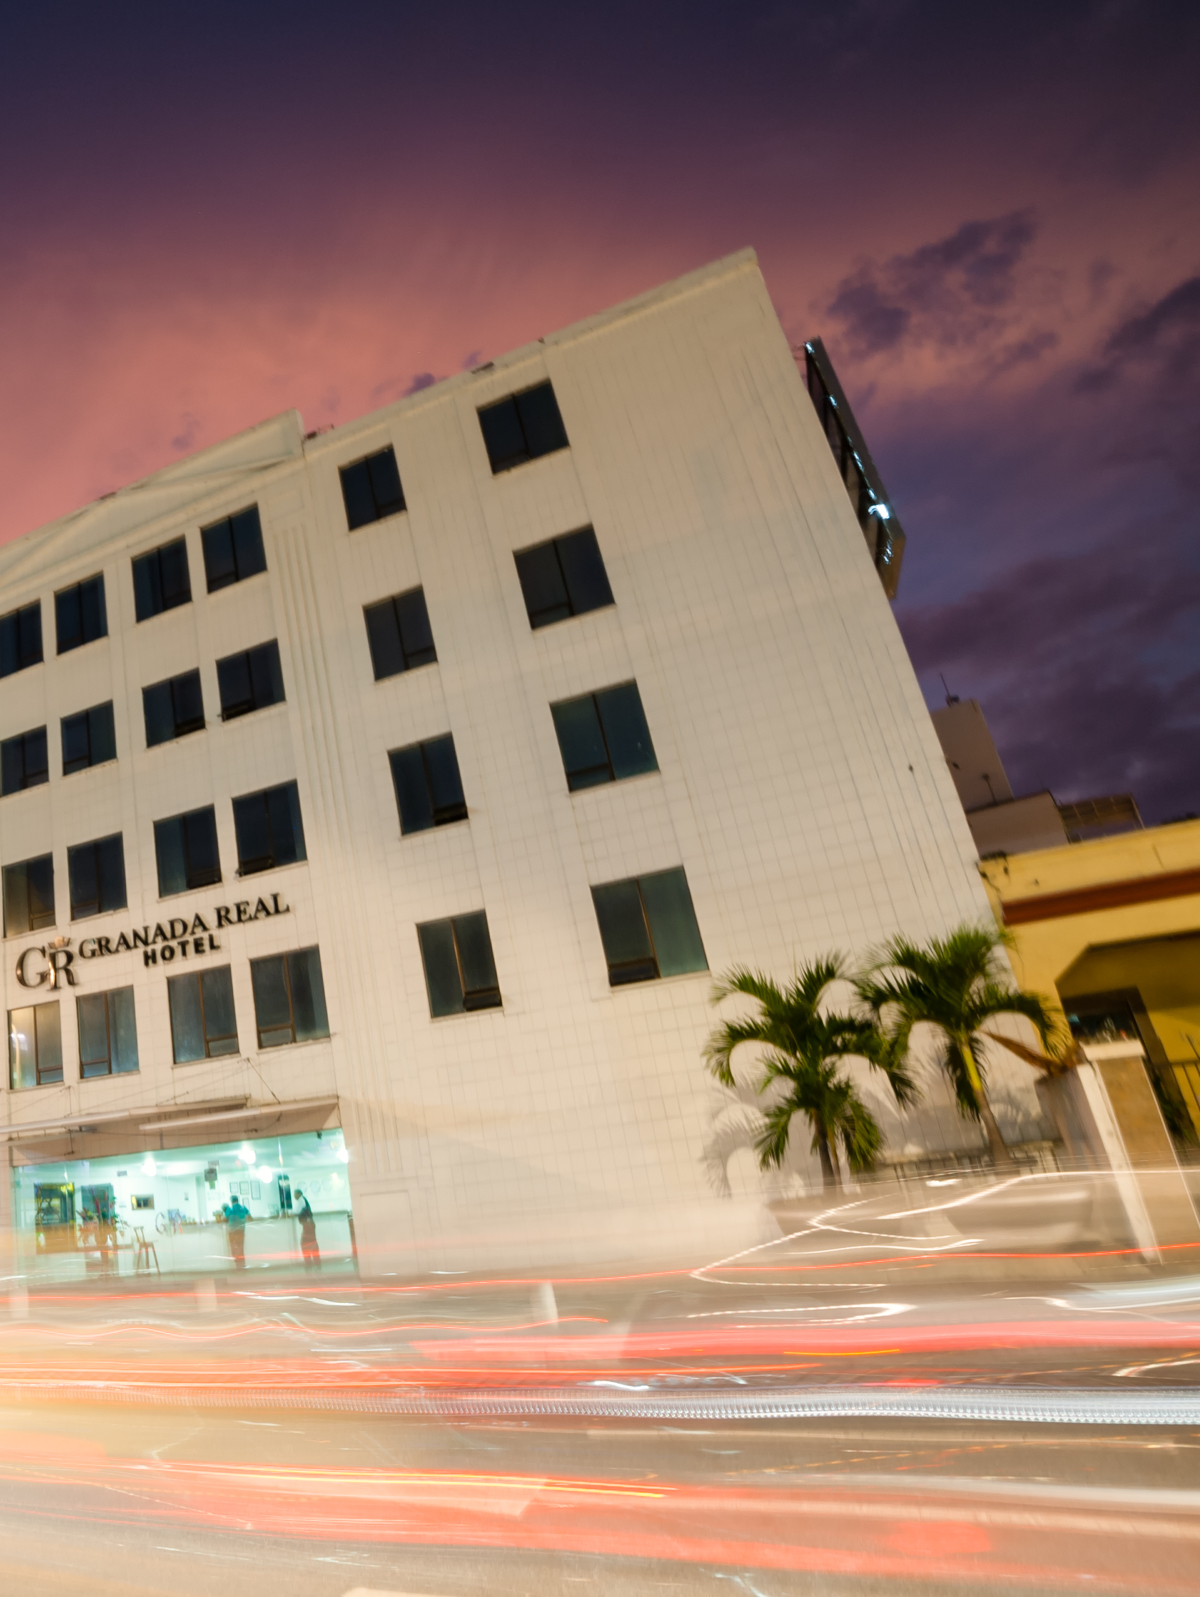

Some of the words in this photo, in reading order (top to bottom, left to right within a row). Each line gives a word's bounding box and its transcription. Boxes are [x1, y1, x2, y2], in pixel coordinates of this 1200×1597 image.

[78, 913, 210, 959] GRANADA
[214, 892, 291, 929] REAL
[15, 945, 80, 992] GR
[143, 933, 222, 968] HOTEL
